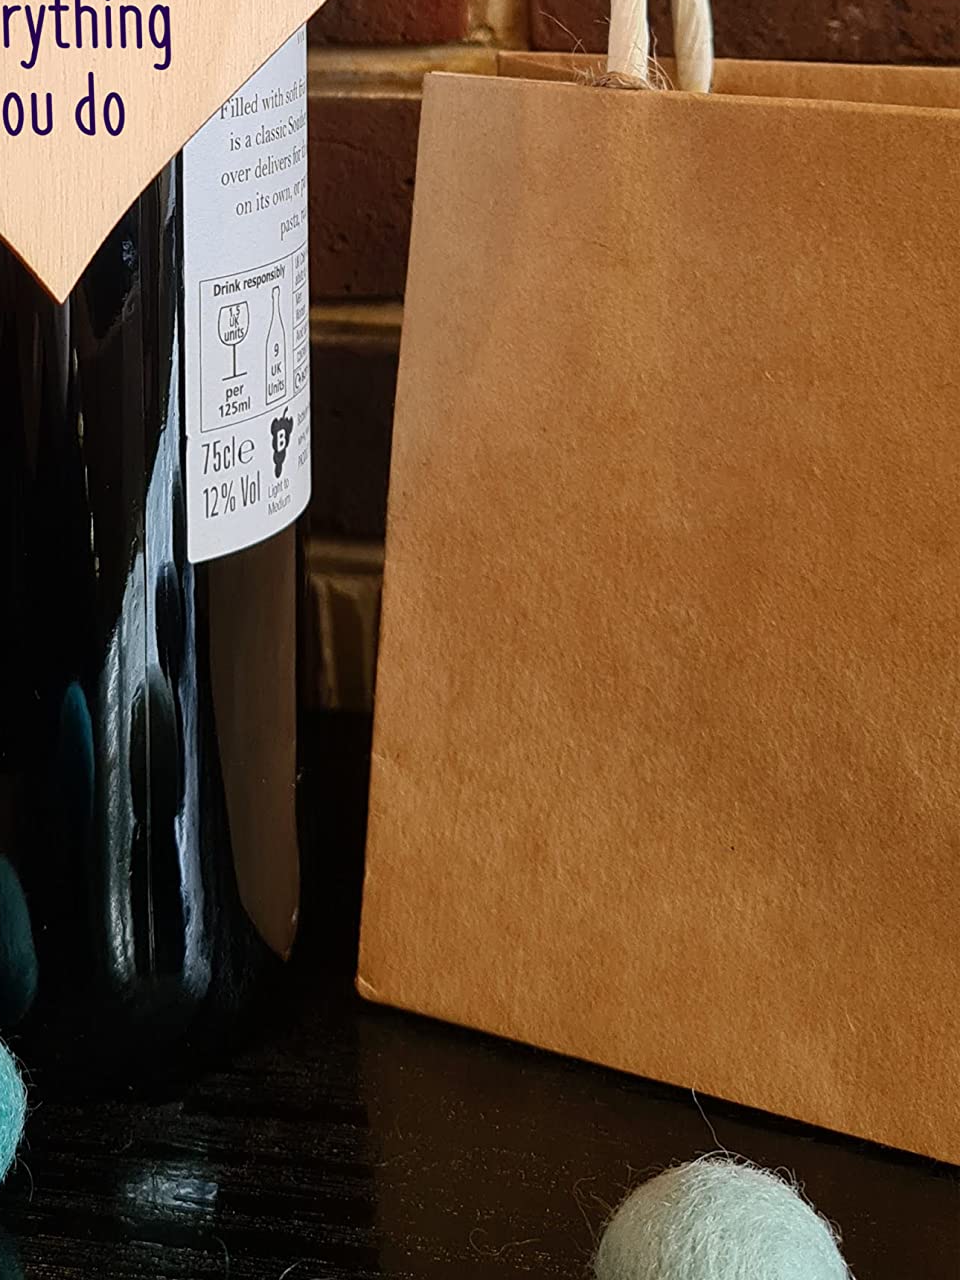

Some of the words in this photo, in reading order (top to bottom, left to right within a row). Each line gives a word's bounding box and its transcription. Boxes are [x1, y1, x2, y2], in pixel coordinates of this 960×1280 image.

[74, 71, 126, 137] do
[220, 95, 259, 120] Filled
[262, 87, 284, 111] with
[230, 131, 241, 152] is
[245, 134, 252, 149] a
[255, 119, 288, 146] classic
[221, 166, 252, 187] over
[254, 153, 292, 180] delivers
[235, 201, 252, 217] on
[256, 191, 270, 212] its
[213, 279, 241, 297] Drink
[243, 264, 286, 291] responsibly
[224, 327, 245, 342] units
[229, 316, 240, 328] UK
[273, 343, 280, 357] 9
[271, 361, 282, 377] UK
[226, 384, 245, 402] per
[268, 379, 285, 397] Units
[218, 397, 251, 418] 125ml
[276, 428, 287, 453] B
[202, 480, 236, 519] 12%
[240, 470, 261, 508] Vol
